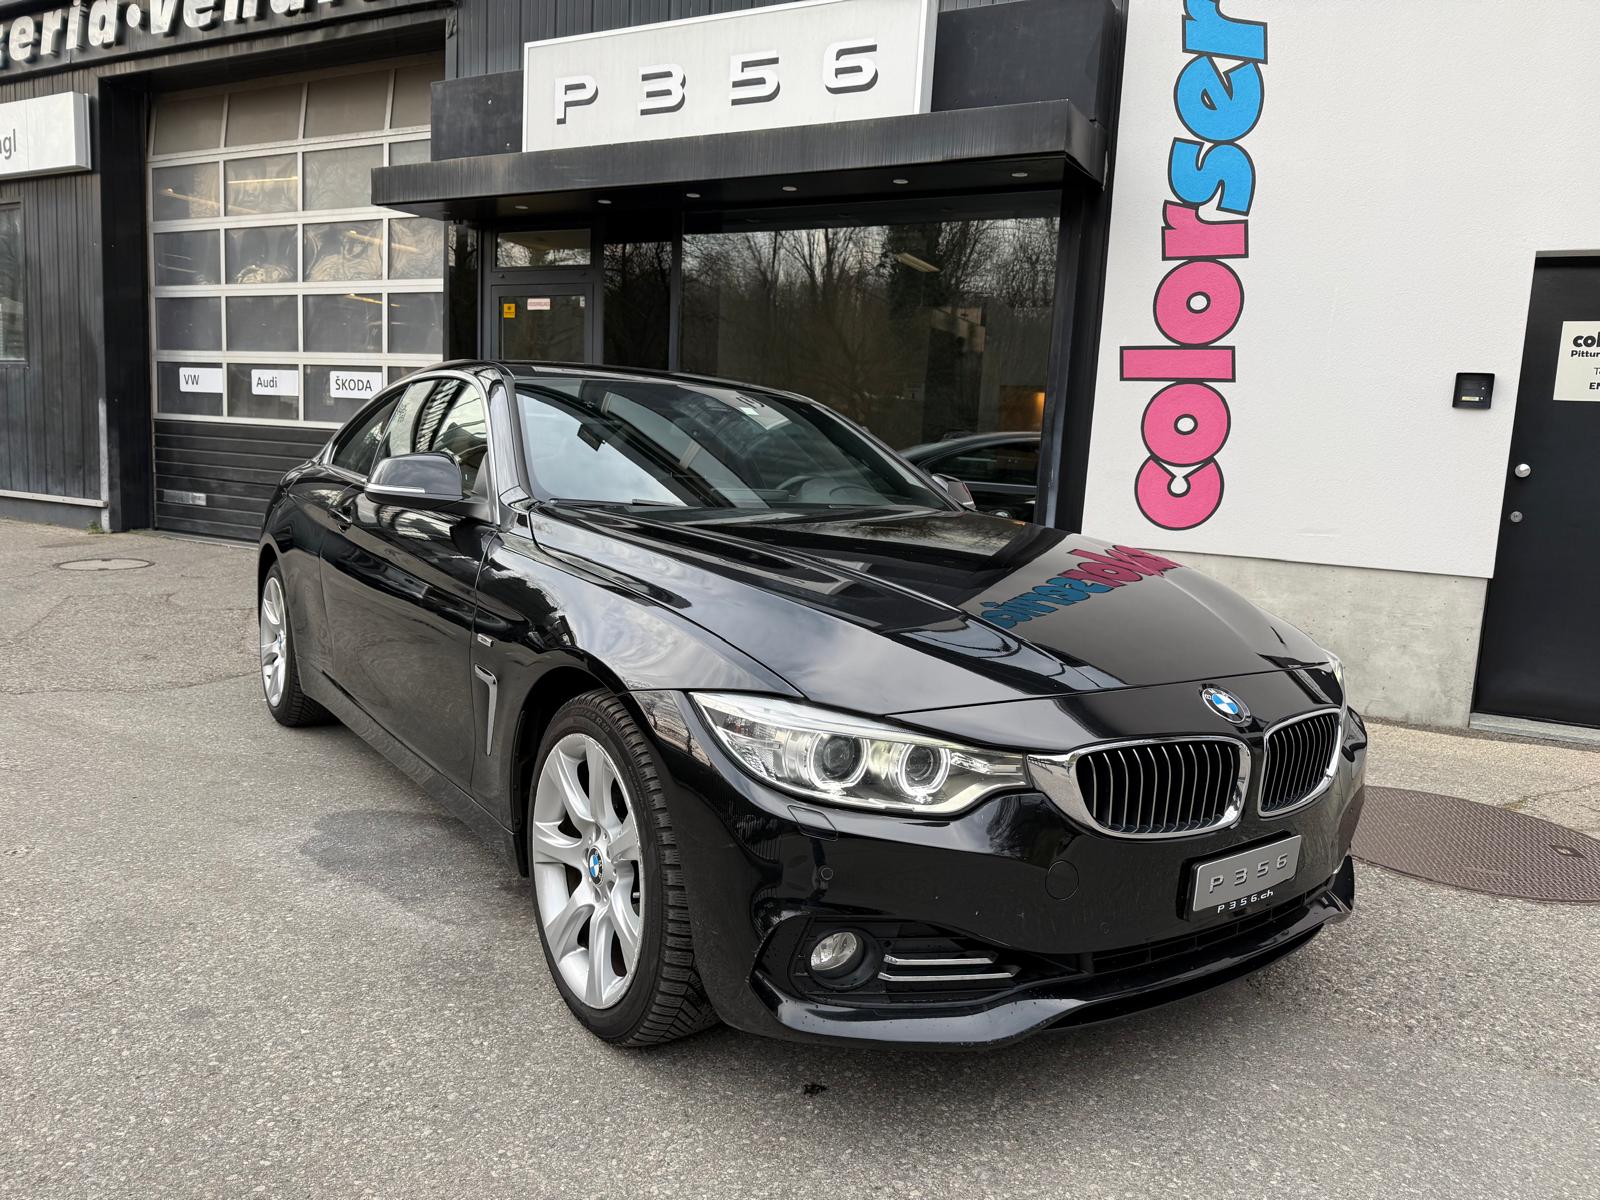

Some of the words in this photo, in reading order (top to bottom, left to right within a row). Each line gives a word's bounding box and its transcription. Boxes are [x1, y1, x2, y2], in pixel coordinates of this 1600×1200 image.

[0, 128, 17, 160] gl
[1593, 367, 1600, 375] T
[183, 374, 200, 386] VW
[256, 376, 278, 389] Audi
[335, 376, 373, 392] ŠKODA
